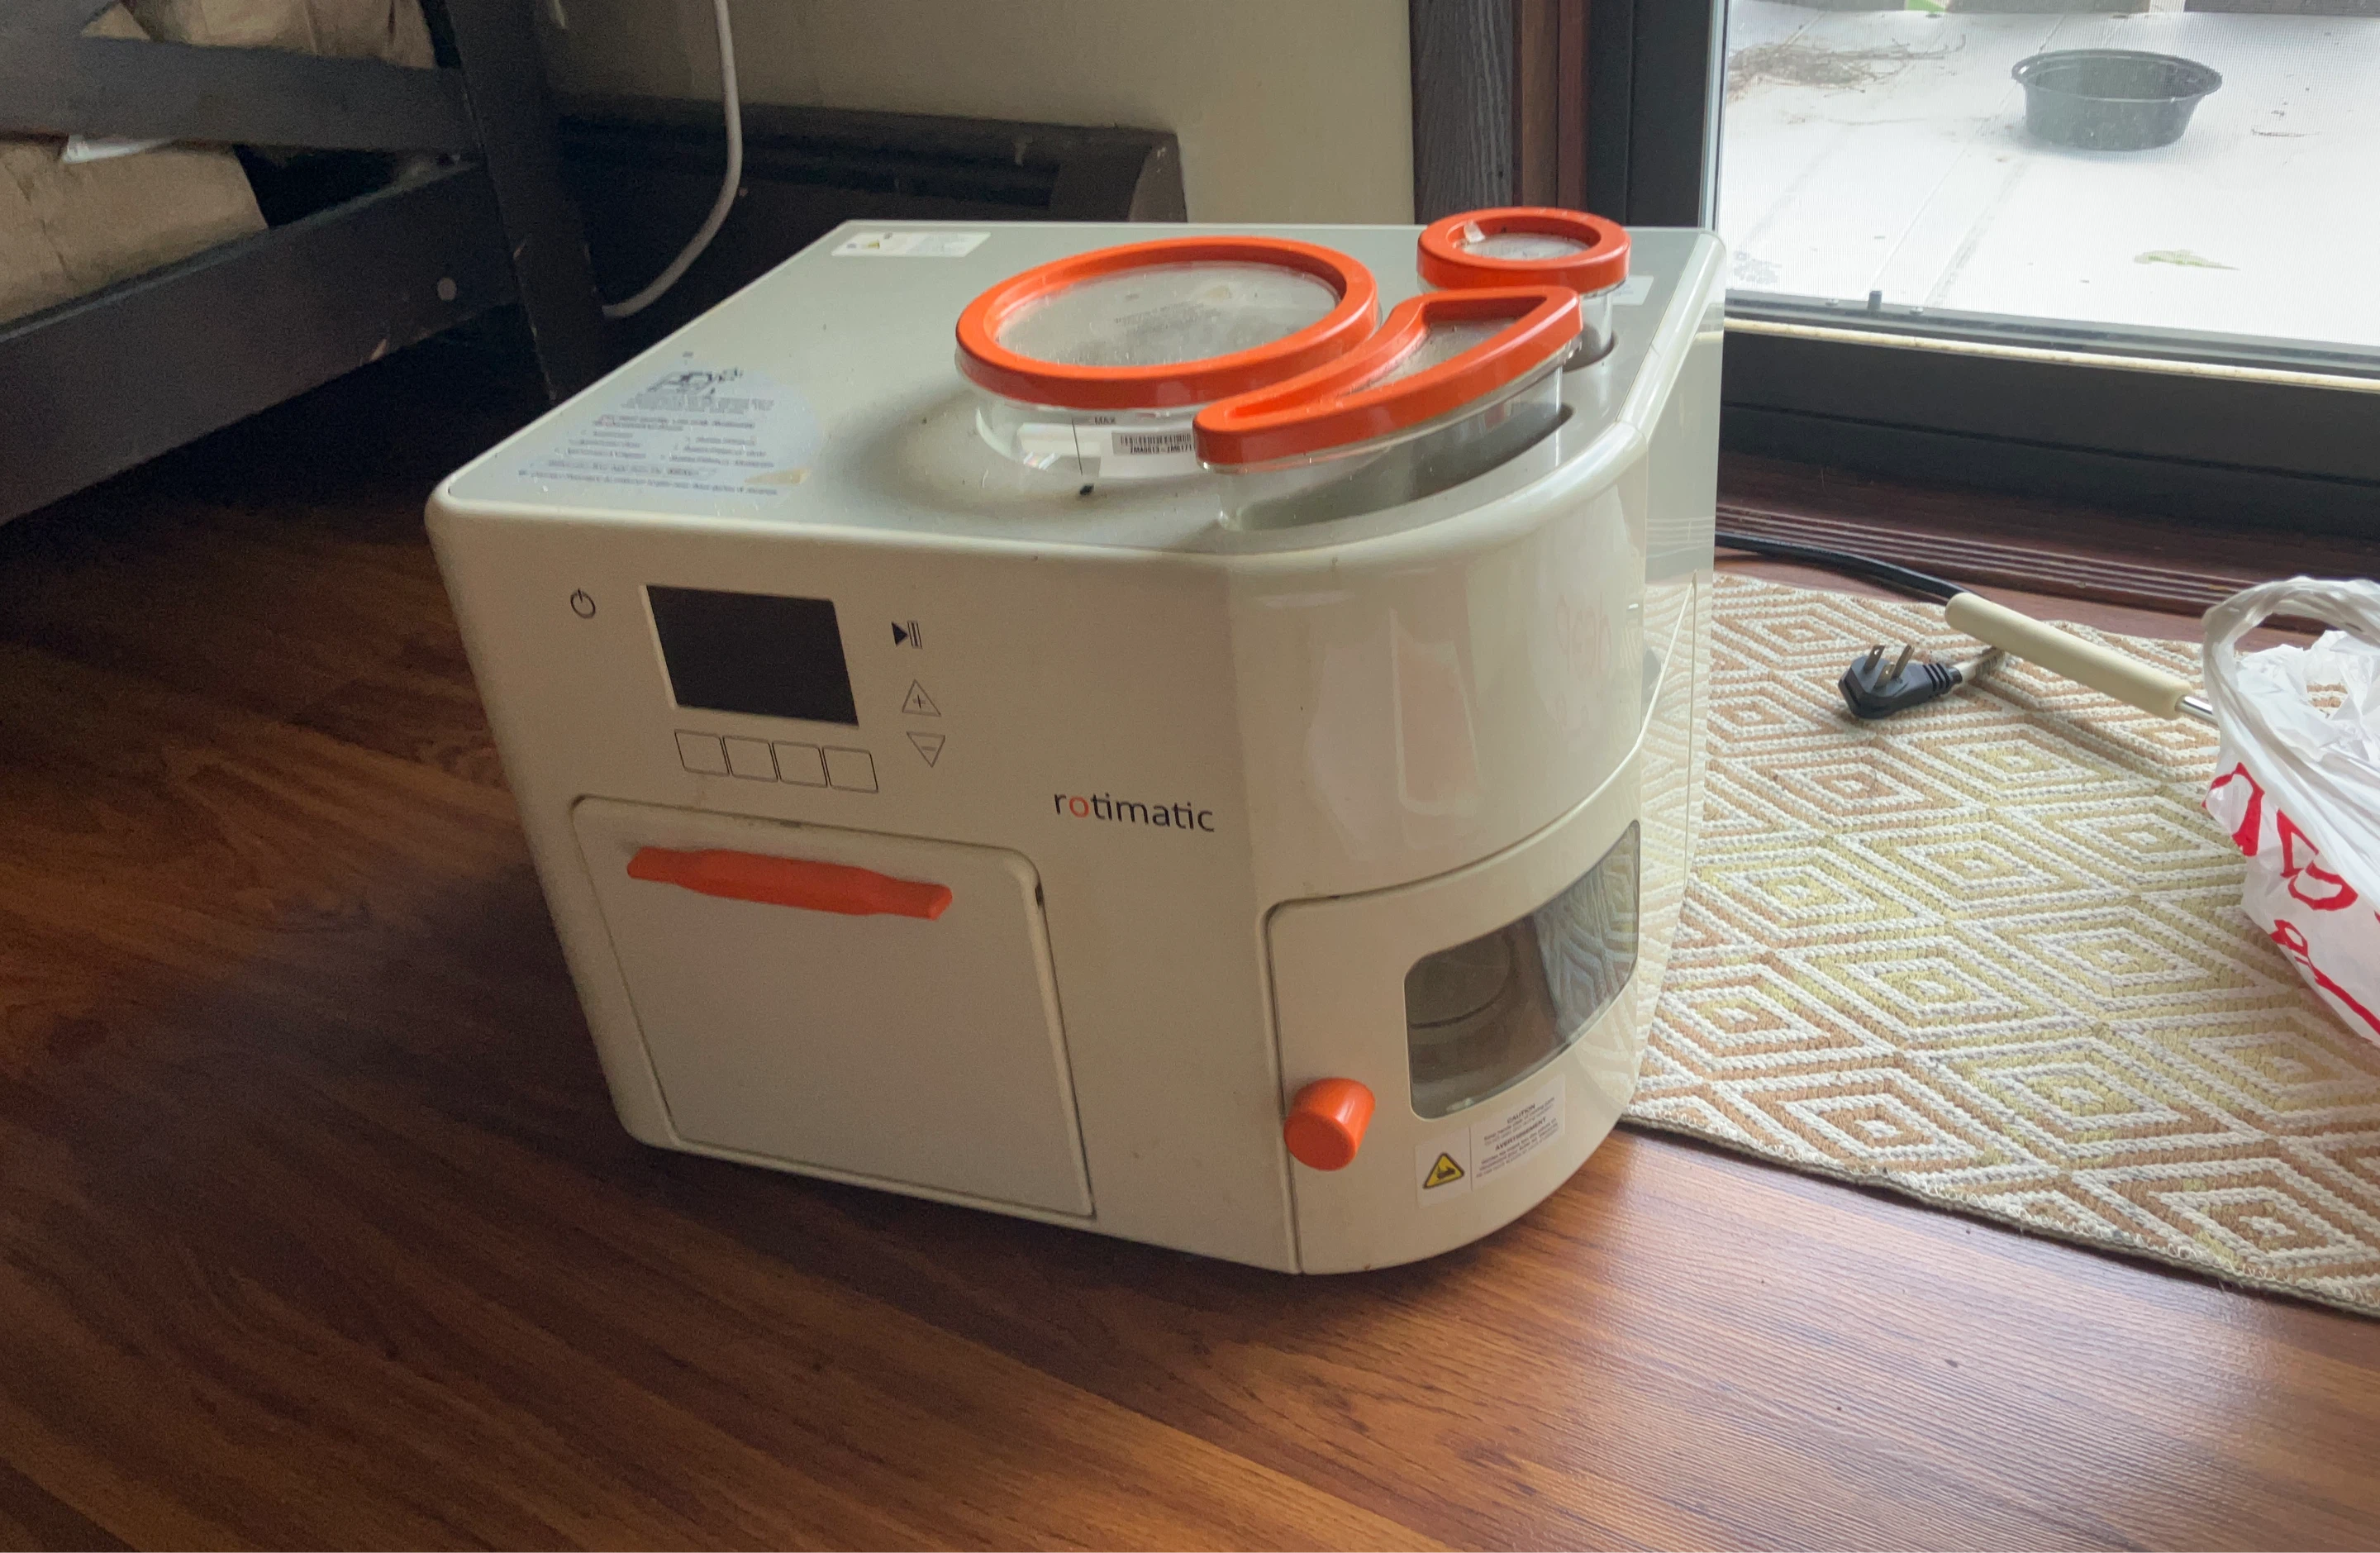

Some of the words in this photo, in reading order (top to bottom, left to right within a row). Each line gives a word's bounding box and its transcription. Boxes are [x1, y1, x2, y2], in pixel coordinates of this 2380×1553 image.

[1094, 416, 1116, 426] MAX
[1054, 792, 1215, 833] rotimatic
[1507, 1103, 1535, 1124] CAUTION
